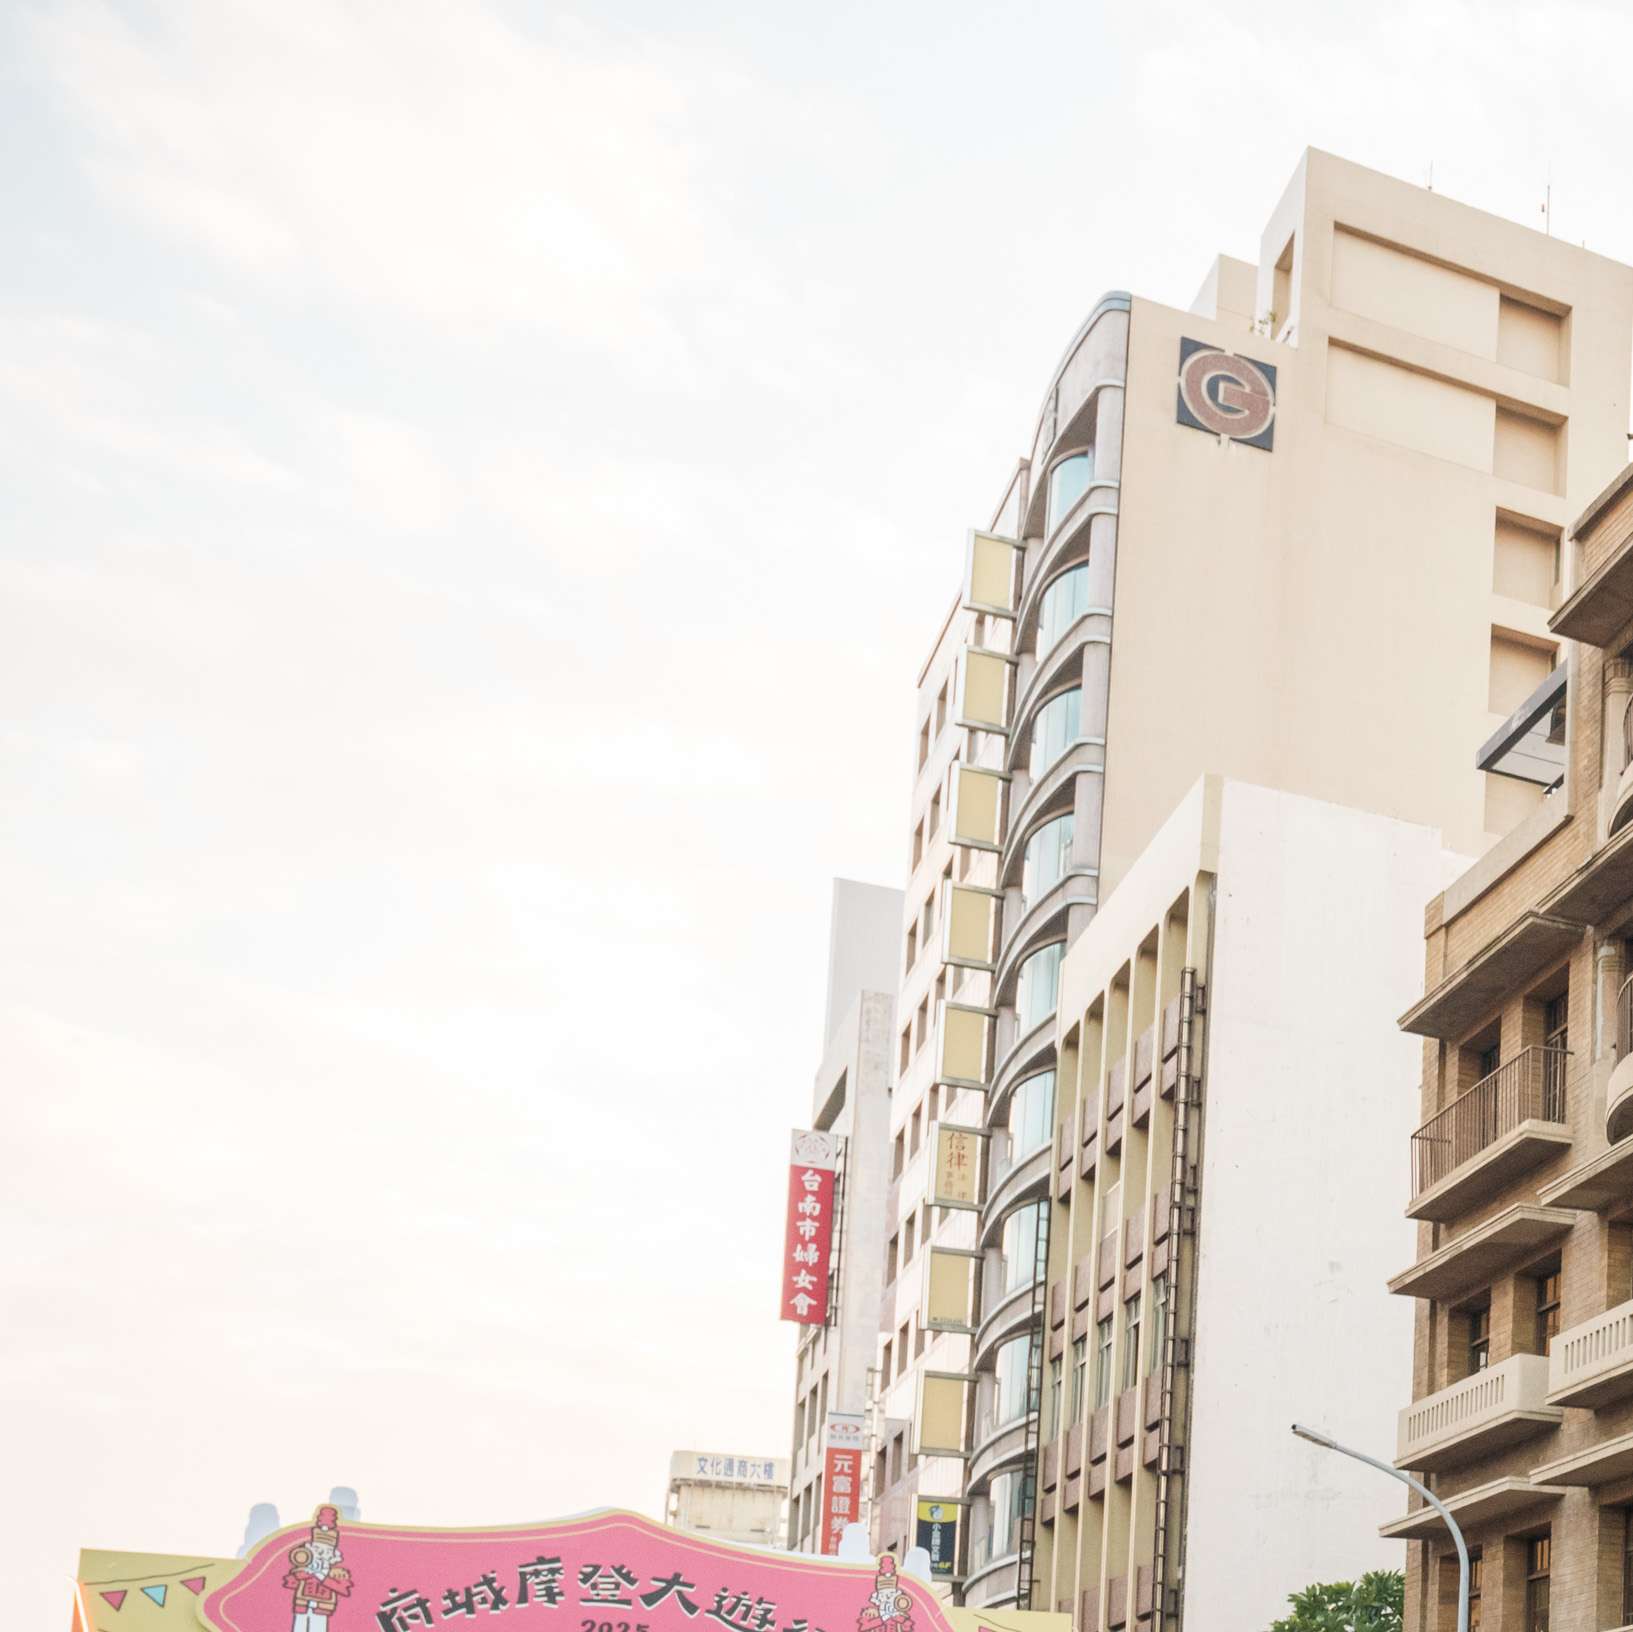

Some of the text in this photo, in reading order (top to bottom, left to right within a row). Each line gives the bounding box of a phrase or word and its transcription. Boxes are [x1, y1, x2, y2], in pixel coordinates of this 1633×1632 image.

[789, 1169, 822, 1316] 台南市婦女會
[830, 1454, 854, 1535] 元富證券
